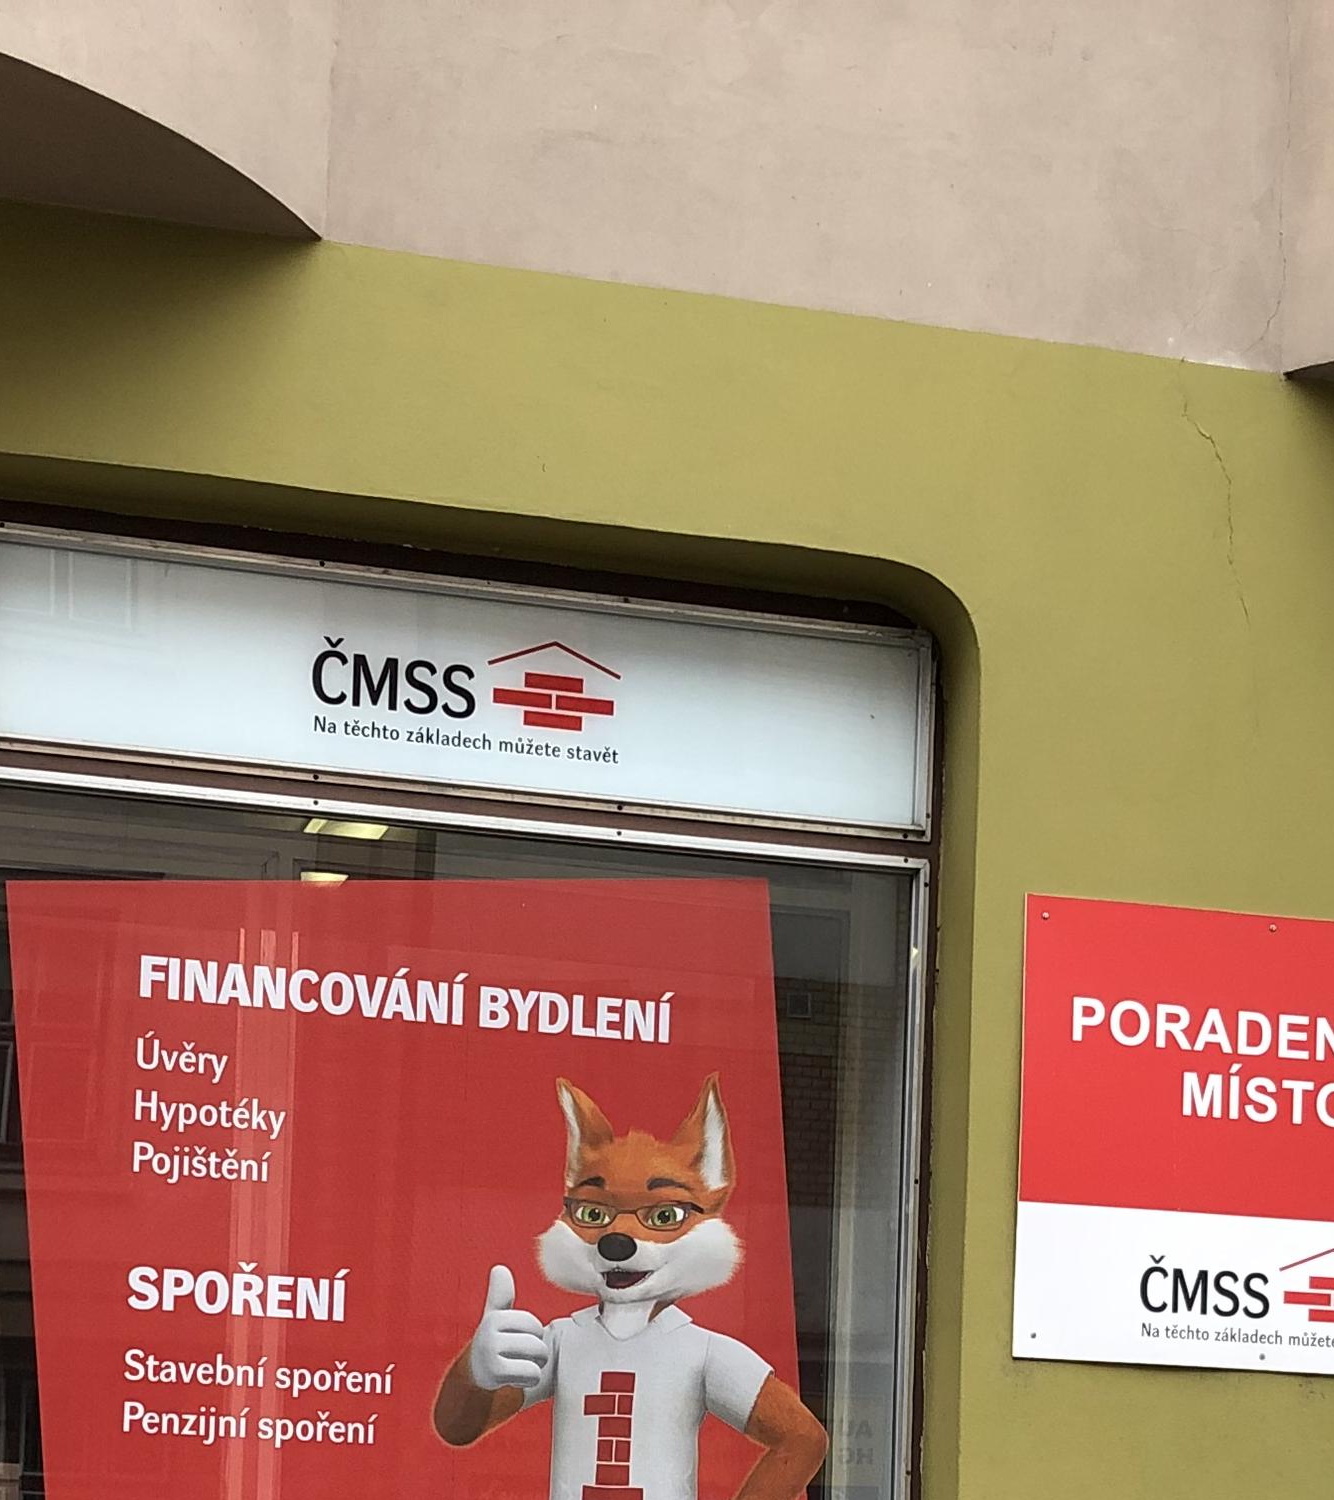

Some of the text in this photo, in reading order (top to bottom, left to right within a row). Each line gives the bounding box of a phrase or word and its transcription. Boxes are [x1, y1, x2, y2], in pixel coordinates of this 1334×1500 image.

[312, 635, 476, 719] ČMSS
[313, 715, 620, 765] Na těchto základech můžete stavět
[139, 954, 675, 1044] FINANCOVÁNÍ BYDLENÍ
[136, 1030, 229, 1084] Úvěry
[134, 1089, 286, 1140] Hypotéky
[132, 1141, 272, 1184] Pojištění
[127, 1261, 350, 1322] SPOŘENÍ
[1139, 1254, 1270, 1320] ČMSS
[1141, 1322, 1161, 1338] Na
[1165, 1324, 1209, 1342] těchto
[1214, 1327, 1283, 1345] základech
[124, 1348, 395, 1398] Stavební spoření
[122, 1401, 378, 1449] Penzijní spoření
